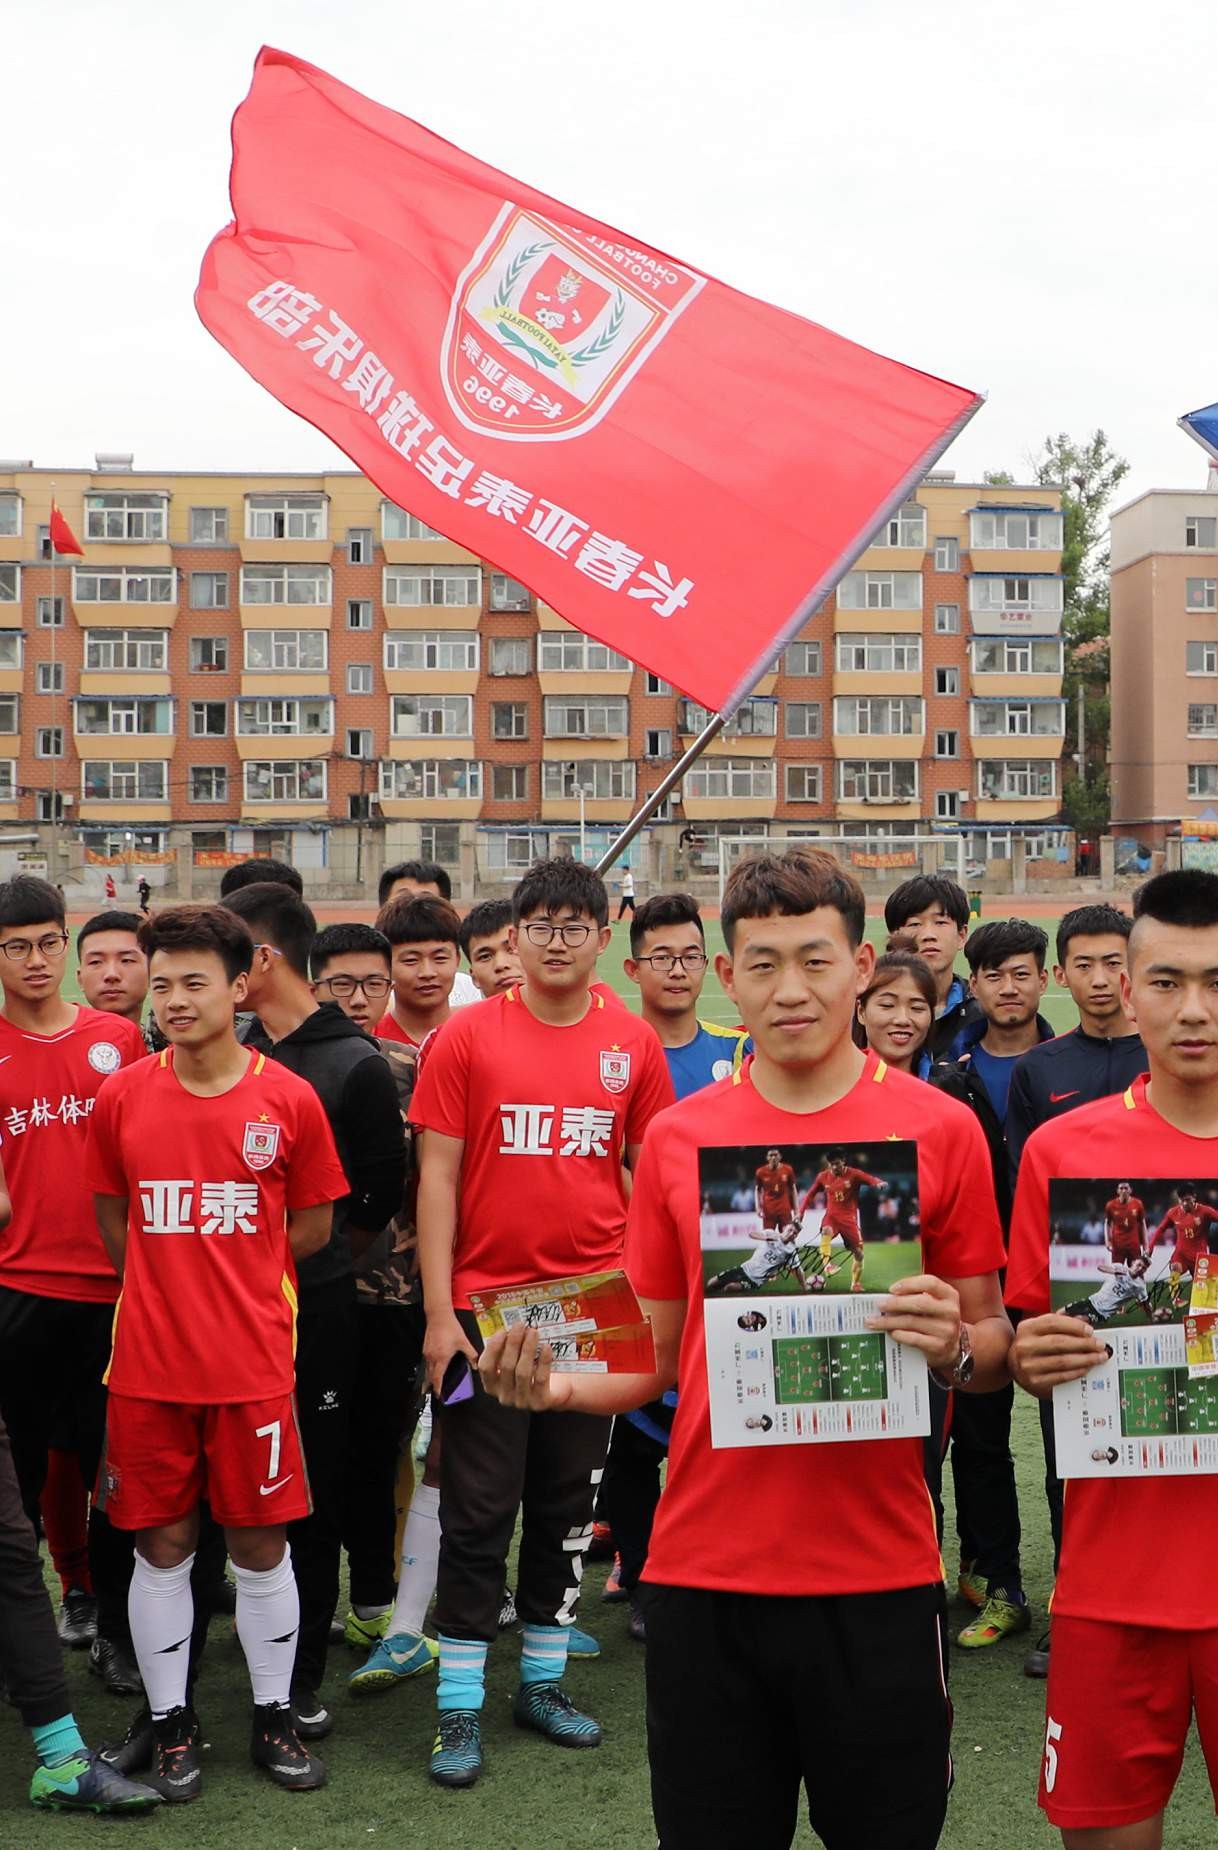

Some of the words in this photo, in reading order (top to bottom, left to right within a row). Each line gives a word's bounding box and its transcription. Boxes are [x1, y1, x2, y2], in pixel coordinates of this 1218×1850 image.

[4, 1094, 97, 1137] 吉林体
[499, 1103, 616, 1157] 亚泰
[138, 1179, 260, 1235] 亚泰
[255, 1419, 281, 1480] 7
